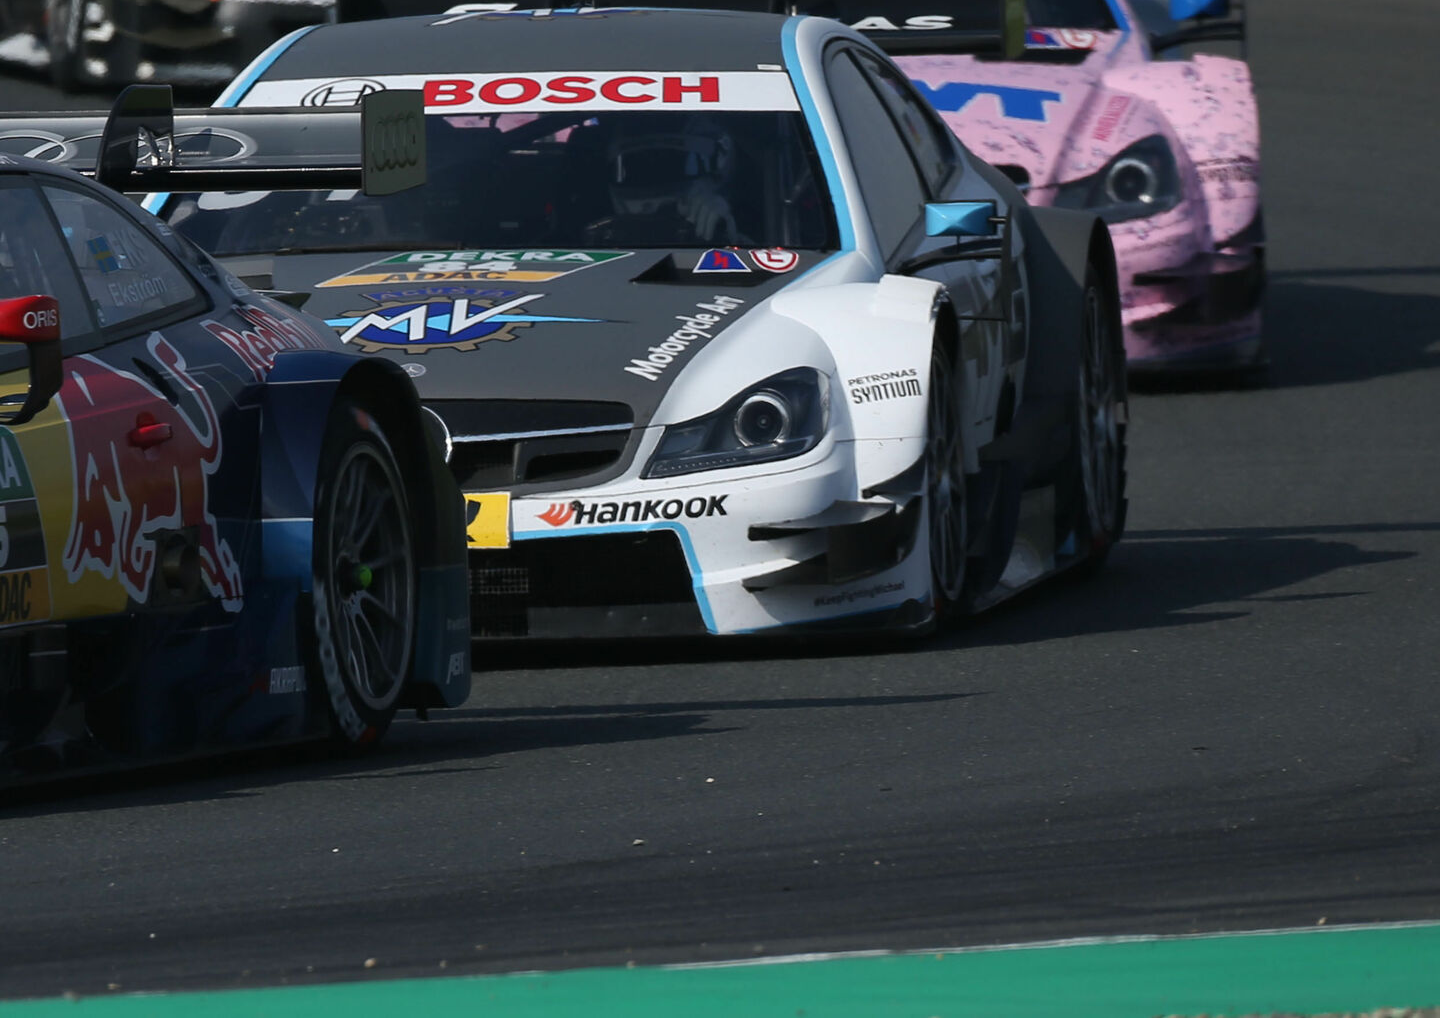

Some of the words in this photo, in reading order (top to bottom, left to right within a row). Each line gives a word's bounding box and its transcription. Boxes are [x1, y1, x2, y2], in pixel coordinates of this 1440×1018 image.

[423, 76, 721, 107] BOSCH
[406, 251, 596, 263] DEKRA
[380, 271, 507, 283] ADAC
[107, 273, 168, 308] Ekström
[22, 309, 59, 330] ORIS
[340, 293, 548, 345] MV
[624, 300, 722, 382] Motorcycle
[710, 295, 745, 318] Art
[847, 368, 918, 387] PETRONAS
[851, 379, 922, 405] SYNTIUM
